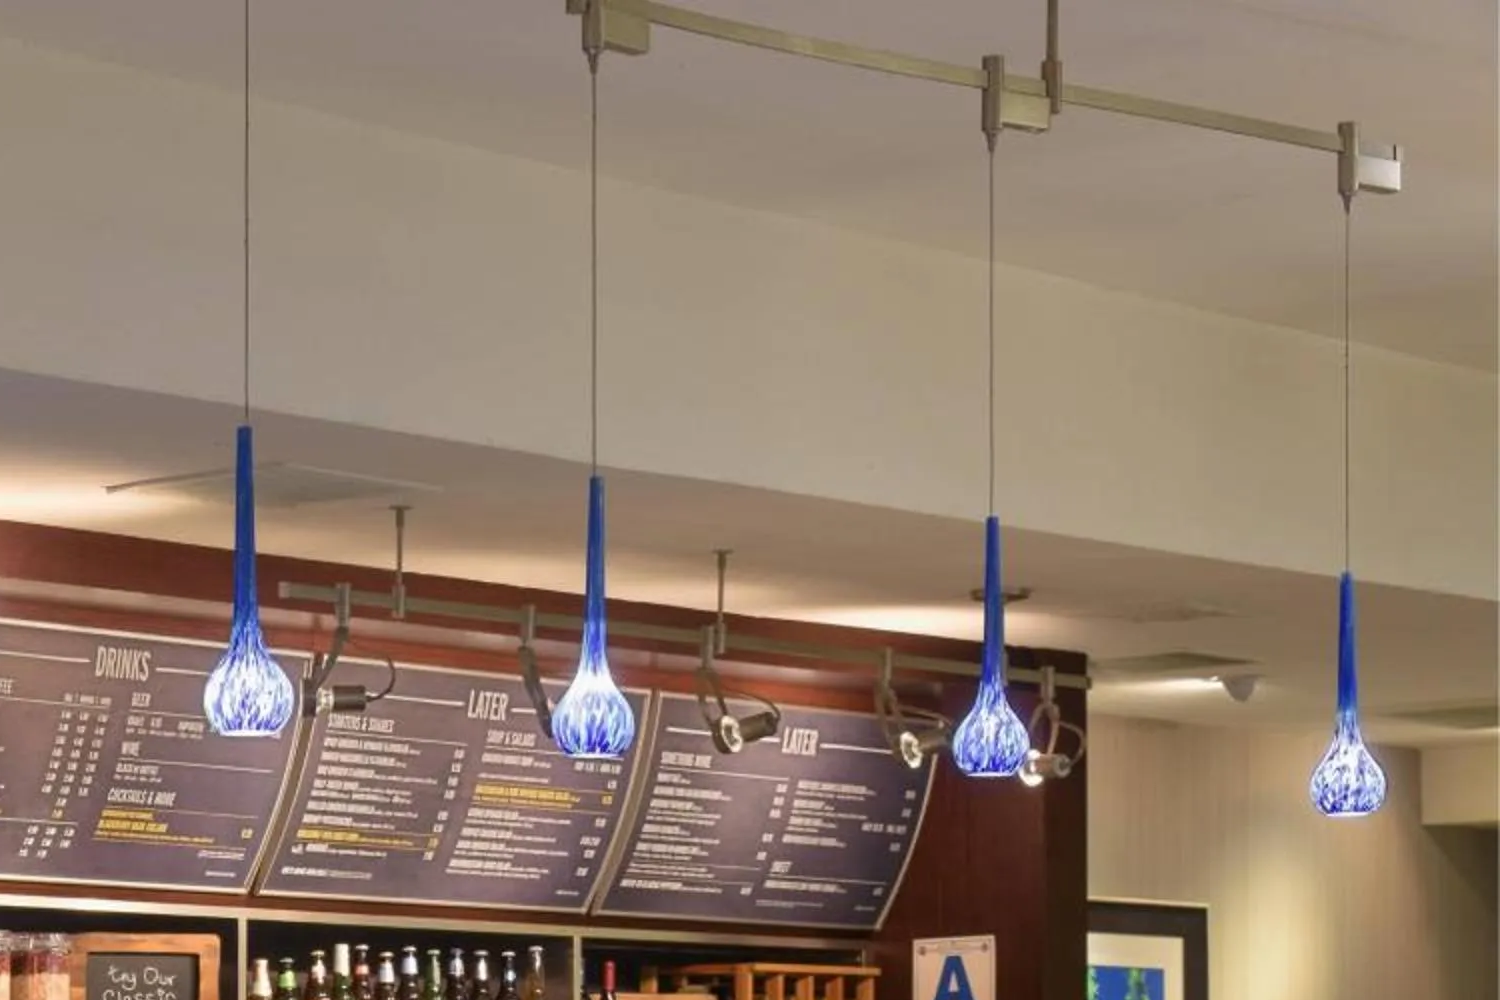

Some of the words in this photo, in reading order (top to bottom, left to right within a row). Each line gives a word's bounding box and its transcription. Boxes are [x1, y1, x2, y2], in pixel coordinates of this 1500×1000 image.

[95, 646, 150, 682] DRINKS
[467, 689, 509, 721] LATER
[781, 726, 819, 757] LATER
[143, 966, 176, 986] Our
